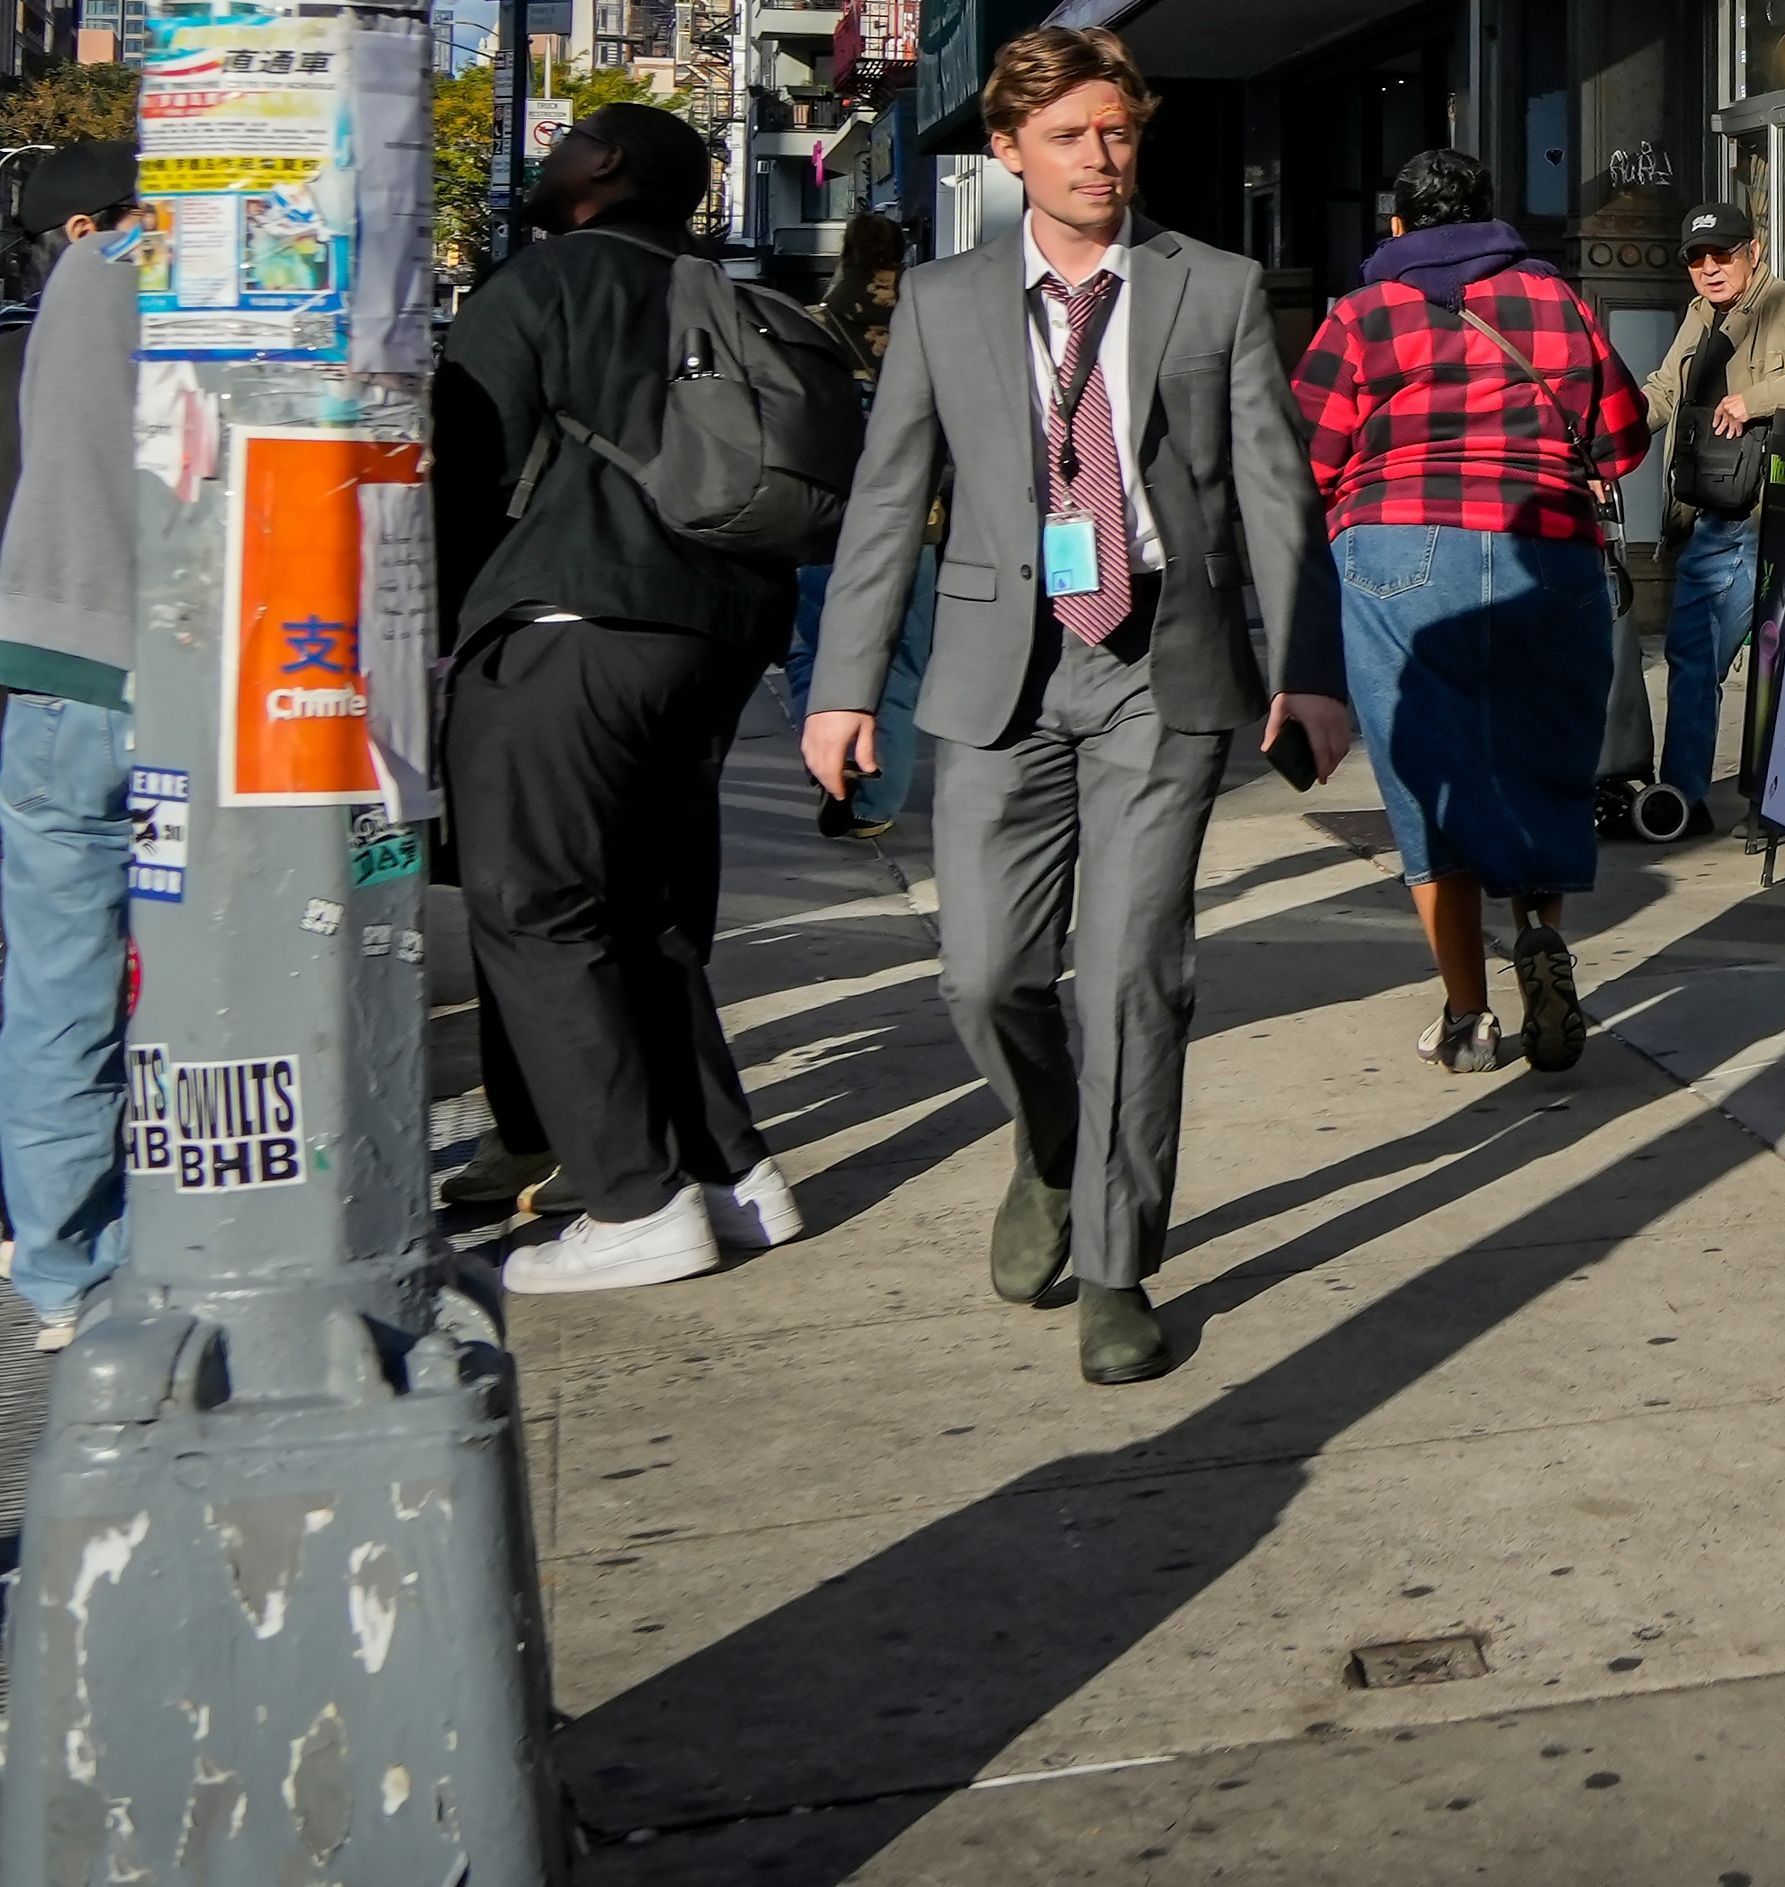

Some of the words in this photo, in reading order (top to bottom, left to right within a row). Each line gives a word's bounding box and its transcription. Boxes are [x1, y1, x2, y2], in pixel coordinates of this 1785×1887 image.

[222, 49, 337, 76] 直通車
[181, 1138, 299, 1187] BHB
